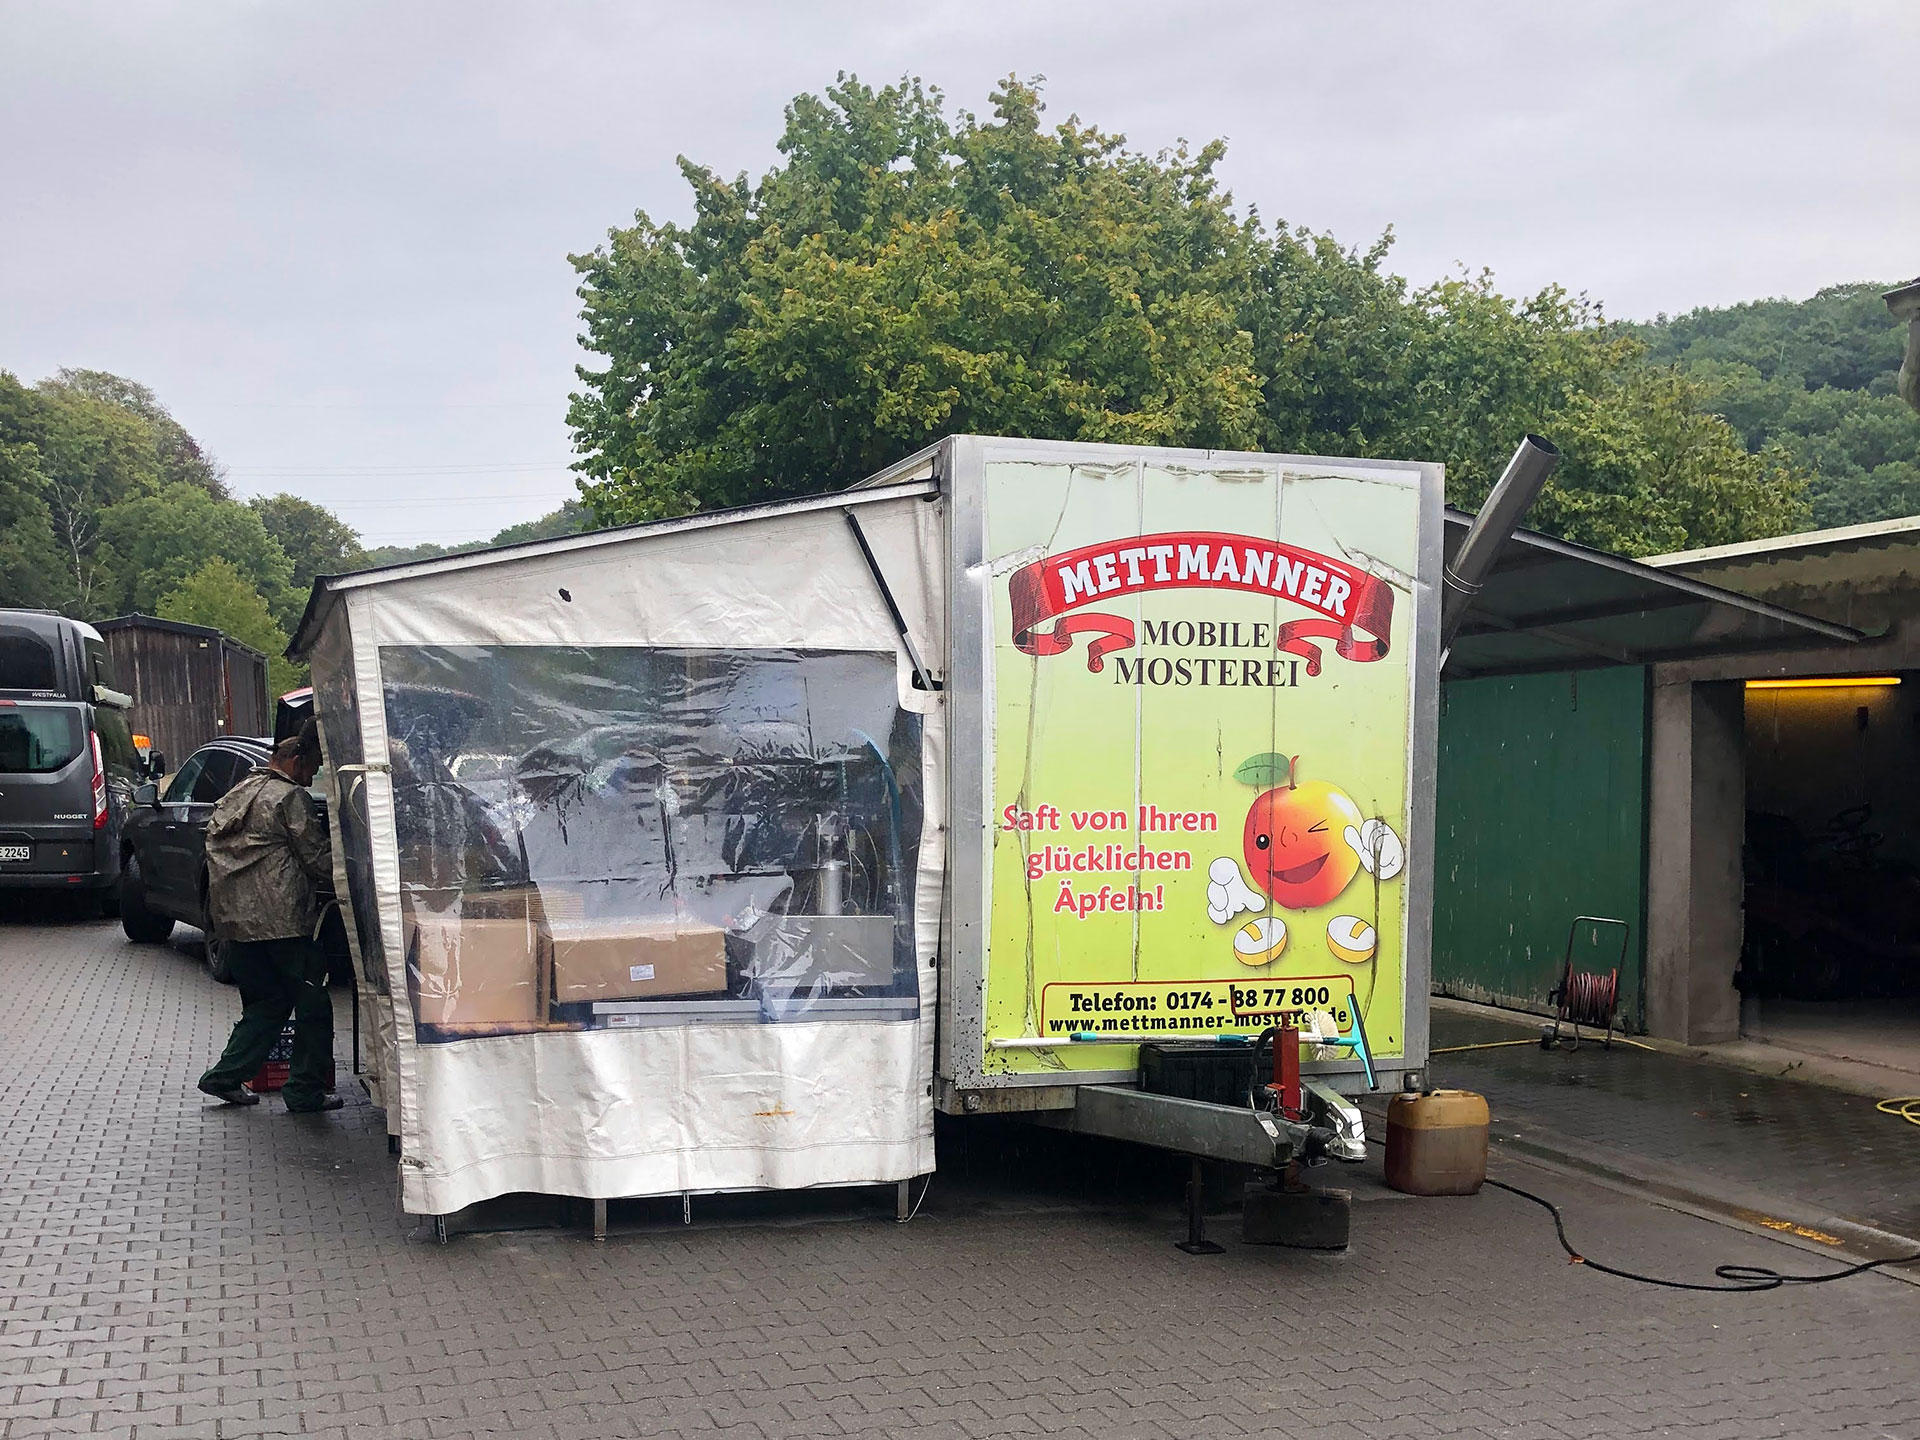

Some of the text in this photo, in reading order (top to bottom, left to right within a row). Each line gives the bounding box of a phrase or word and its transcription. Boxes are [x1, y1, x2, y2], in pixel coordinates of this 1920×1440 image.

[1058, 544, 1352, 618] METTMANNER
[1142, 620, 1270, 648] MOBILE
[1114, 657, 1299, 687] MOSTEREI
[32, 691, 67, 699] WESTFALIA
[1003, 804, 1218, 831] Saft von Ihren
[4, 847, 29, 858] 2245
[1027, 845, 1191, 880] glücklichen
[1054, 880, 1164, 919] Äpfeln!
[1070, 992, 1157, 1012] Telefon:
[1166, 991, 1213, 1010] 0174
[1234, 989, 1258, 1008] 88
[1263, 988, 1286, 1007] 77
[1291, 986, 1330, 1006] 800
